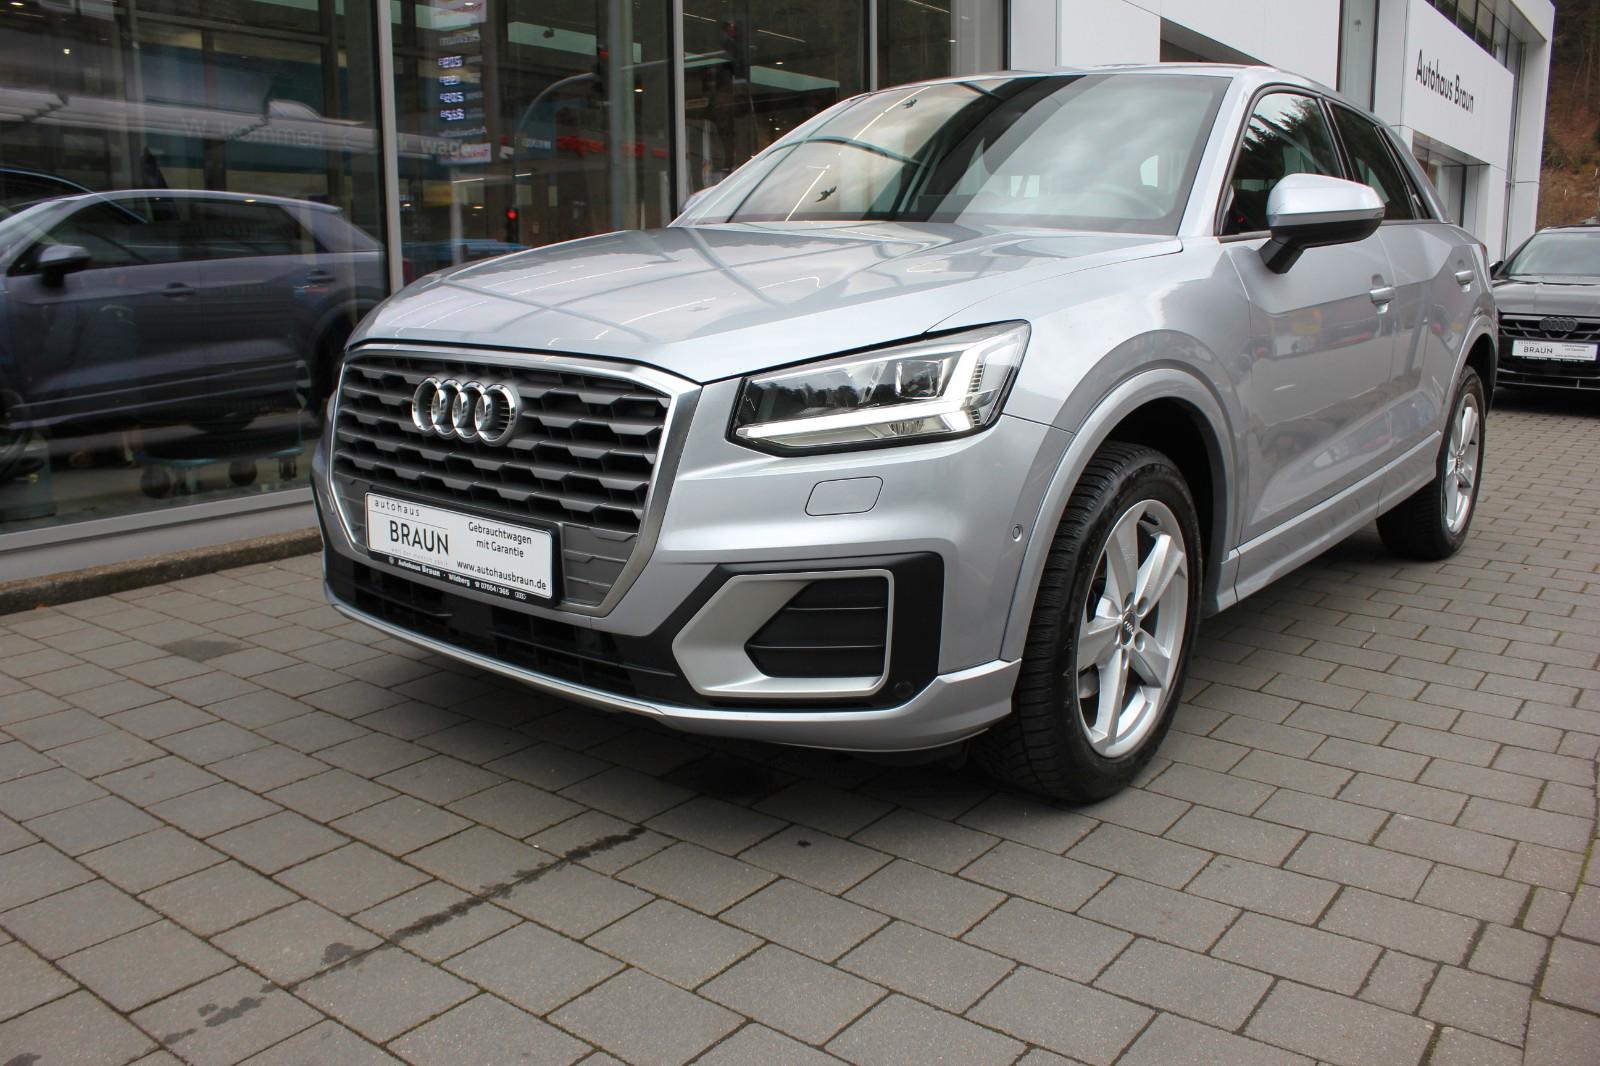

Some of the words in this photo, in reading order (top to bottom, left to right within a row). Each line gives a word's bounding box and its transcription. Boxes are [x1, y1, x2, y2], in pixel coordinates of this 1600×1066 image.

[1416, 49, 1453, 101] Autohaus
[1454, 74, 1474, 114] Braun
[1523, 346, 1553, 354] BRAUN
[373, 498, 421, 518] autohaus
[389, 519, 450, 556] BRAUN
[468, 520, 533, 546] Gebrauchtwagen
[476, 538, 490, 551] mit
[490, 541, 525, 558] Garantie
[421, 563, 441, 577] Braun
[456, 559, 547, 591] www.autohausbraun.de
